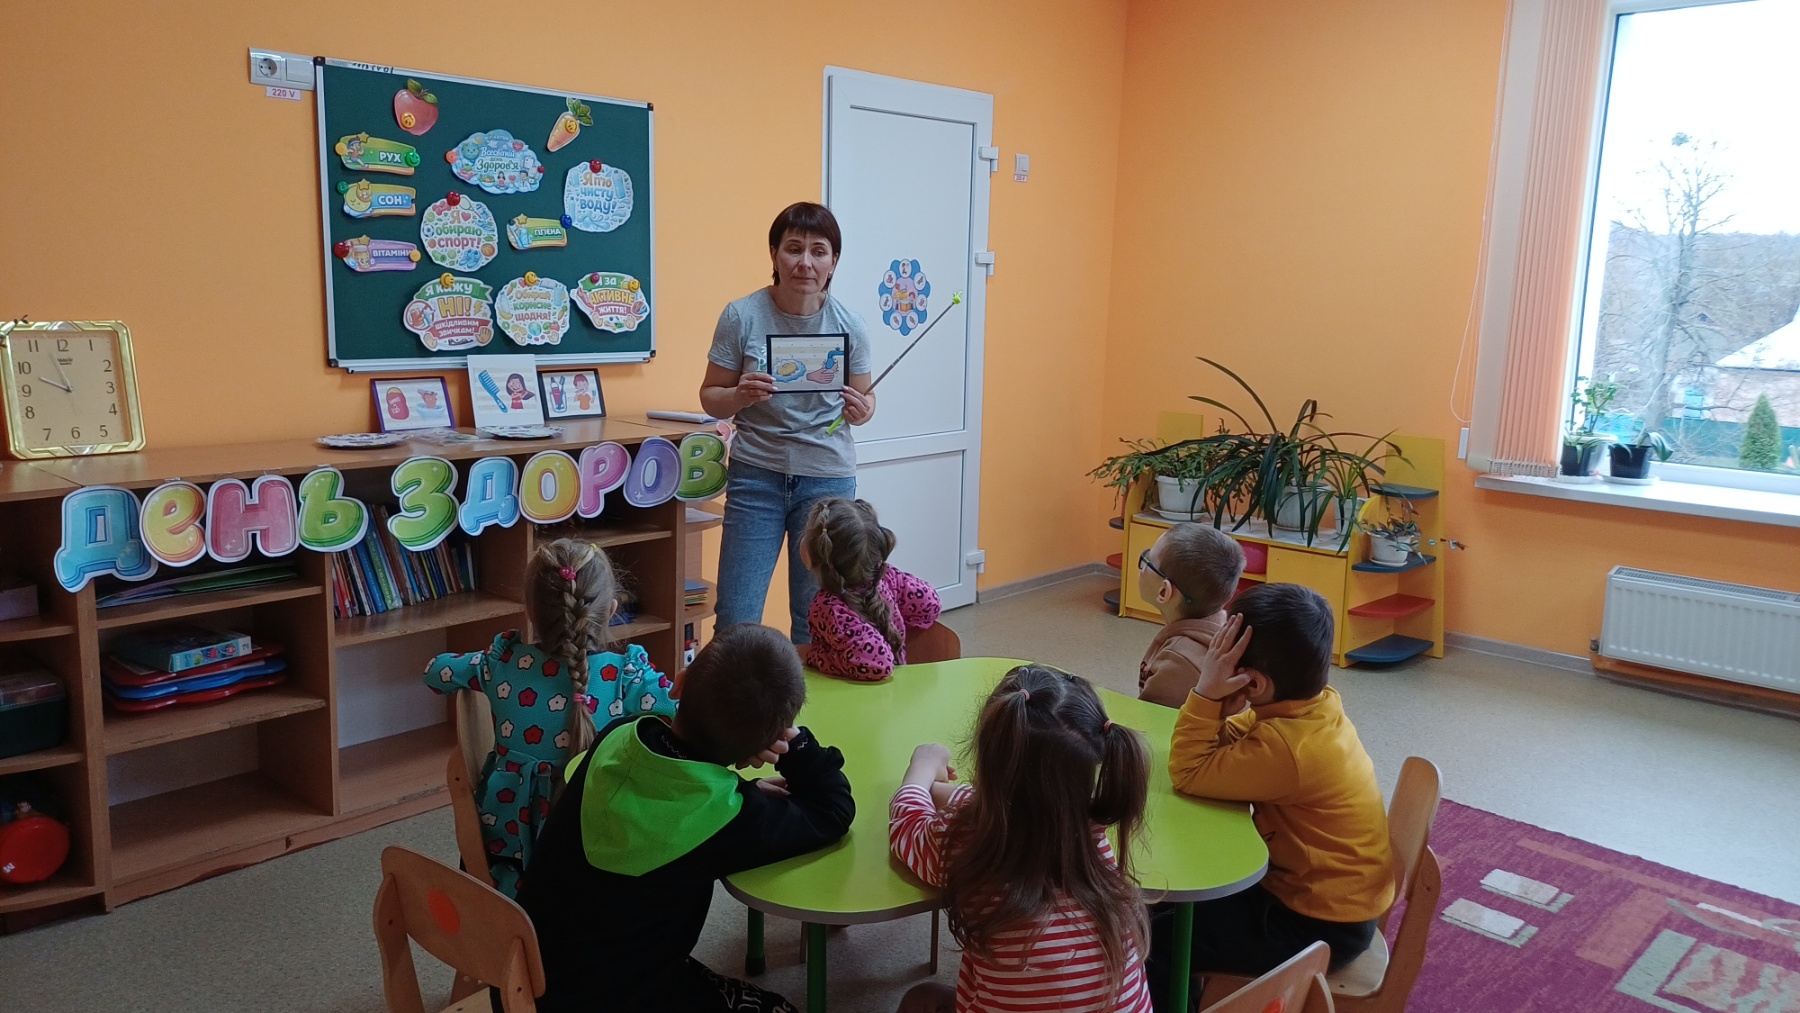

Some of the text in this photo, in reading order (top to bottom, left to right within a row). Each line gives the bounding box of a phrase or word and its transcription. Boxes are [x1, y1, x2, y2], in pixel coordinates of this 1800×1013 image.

[271, 87, 295, 98] 220 V
[380, 151, 402, 163] РУХ
[583, 172, 593, 186] Я
[378, 195, 403, 205] СОН
[580, 187, 615, 202] чисту
[580, 199, 617, 215] воду!
[450, 210, 461, 224] Я
[435, 221, 482, 237] обираю
[437, 237, 482, 250] спорт!
[425, 286, 435, 297] Я
[589, 289, 636, 305] АКТИВНЕ
[437, 296, 472, 318] НІ!
[27, 339, 39, 353] 11
[56, 339, 69, 352] 12
[88, 339, 94, 352] 1
[17, 361, 32, 375] 10
[102, 359, 113, 373] 2
[21, 384, 32, 398] 9
[105, 381, 115, 394] 3
[25, 405, 36, 420] 8
[108, 403, 118, 416] 4
[42, 427, 52, 441] 7
[70, 426, 81, 440] 6
[99, 424, 109, 438] 5
